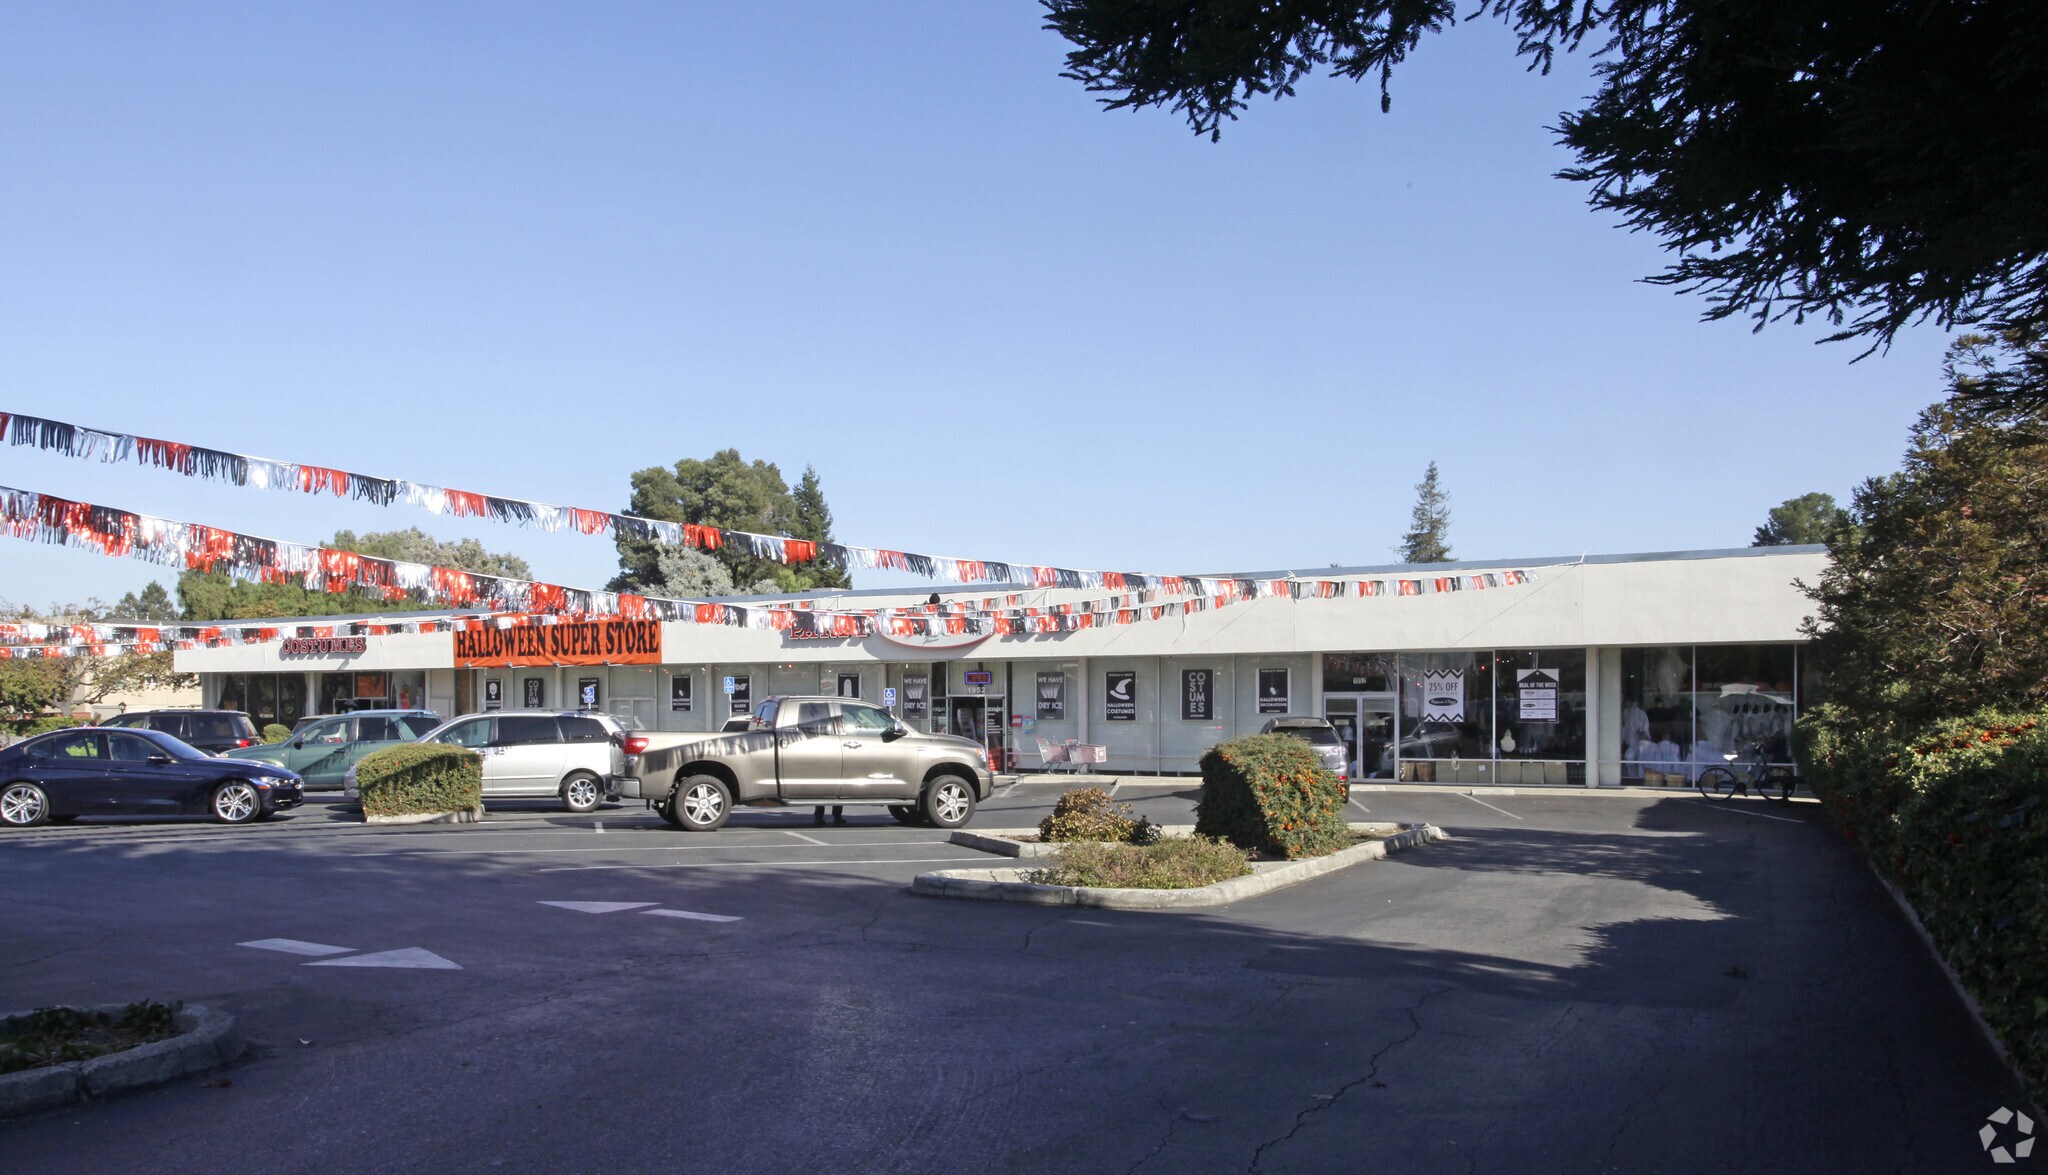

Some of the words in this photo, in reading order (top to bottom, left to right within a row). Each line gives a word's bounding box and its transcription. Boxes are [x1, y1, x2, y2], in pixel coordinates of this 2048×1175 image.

[457, 626, 547, 658] HALLOWEEN
[551, 622, 601, 657] SUPER
[605, 620, 659, 655] STORE
[282, 637, 367, 654] COSTUMES
[967, 686, 986, 694] 1952
[1428, 682, 1444, 692] 25%
[1445, 682, 1458, 691] OFF
[903, 701, 915, 710] DRY
[916, 701, 927, 709] ICE
[1038, 701, 1050, 709] DRY
[1051, 701, 1063, 709] ICE
